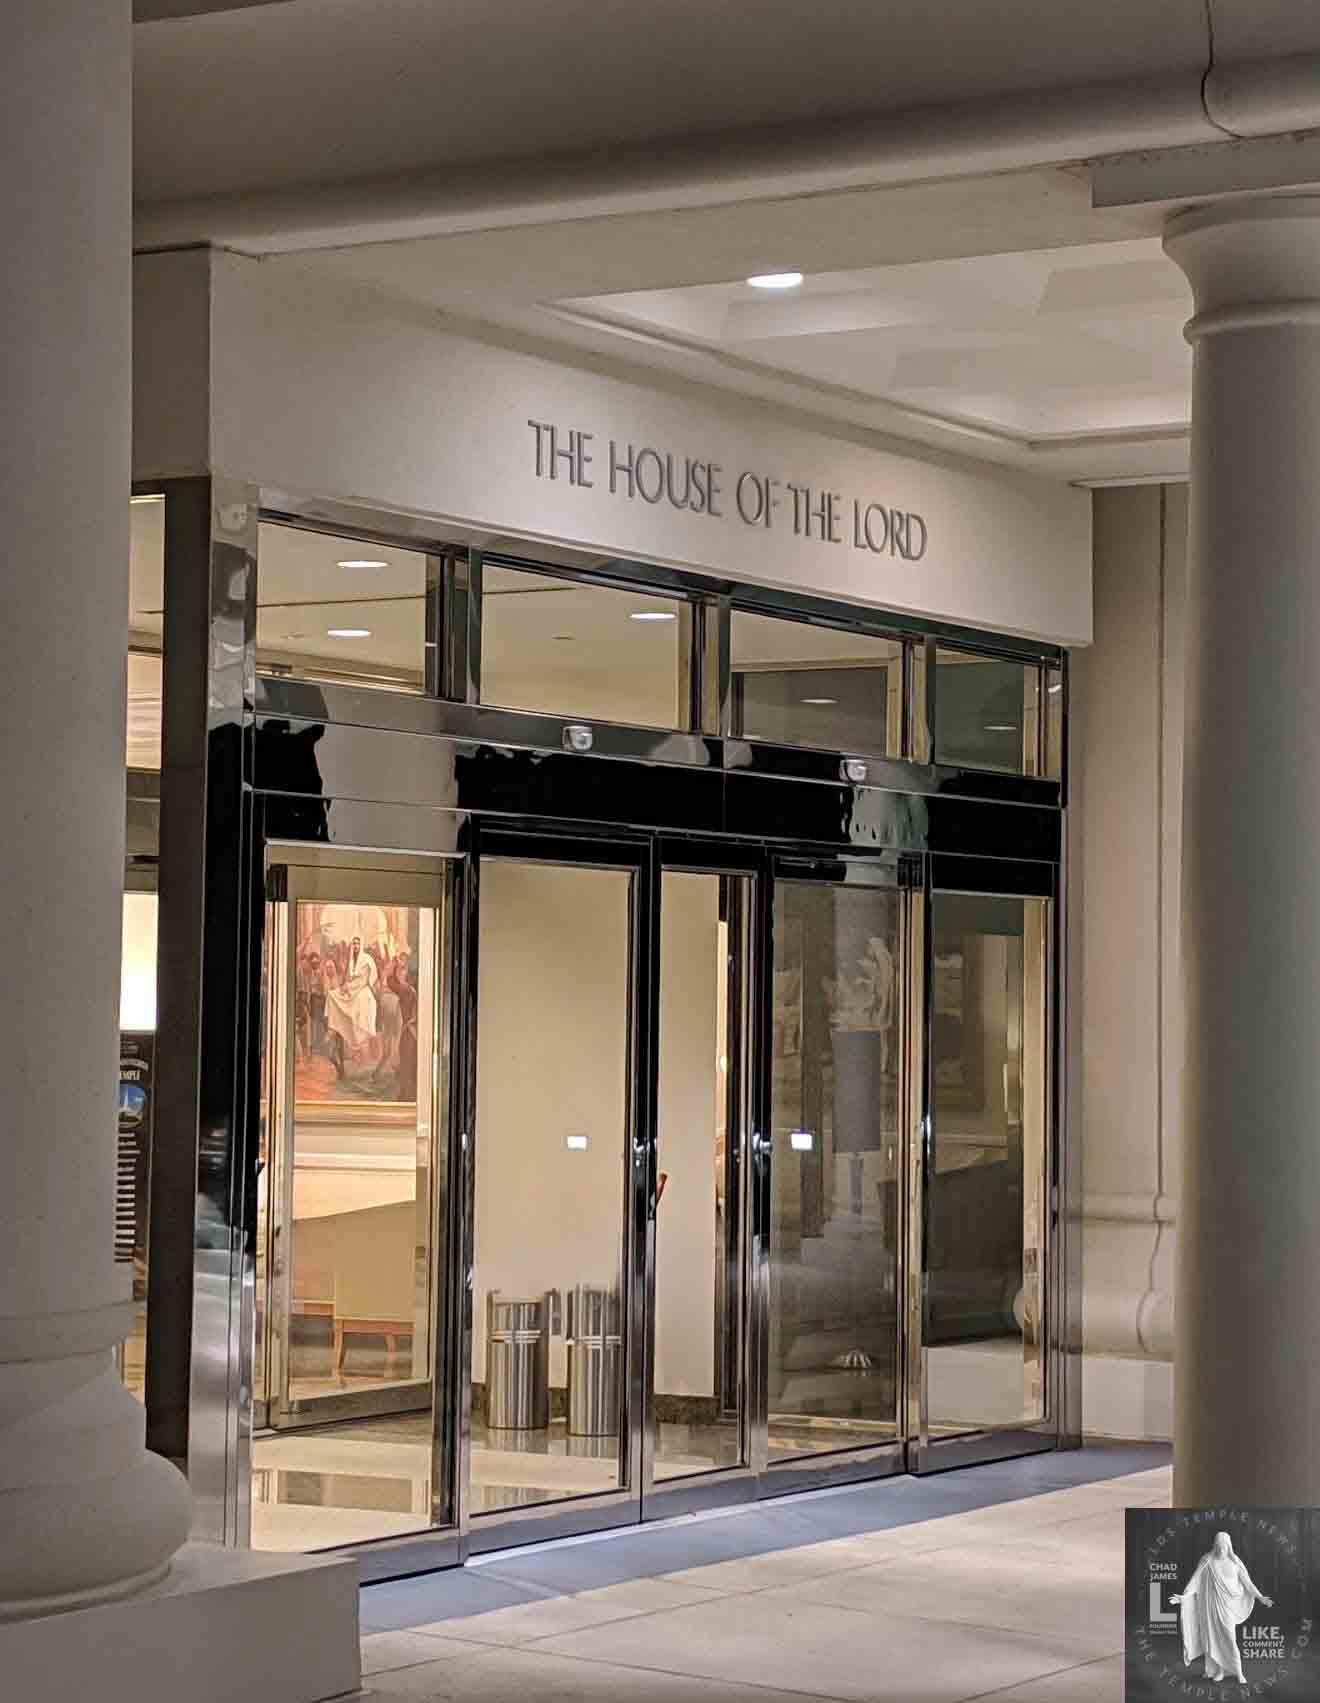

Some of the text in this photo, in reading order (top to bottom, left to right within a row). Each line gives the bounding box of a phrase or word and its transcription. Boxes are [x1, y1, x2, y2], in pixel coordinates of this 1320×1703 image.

[528, 419, 928, 561] THE HOUSE OF THE LORD
